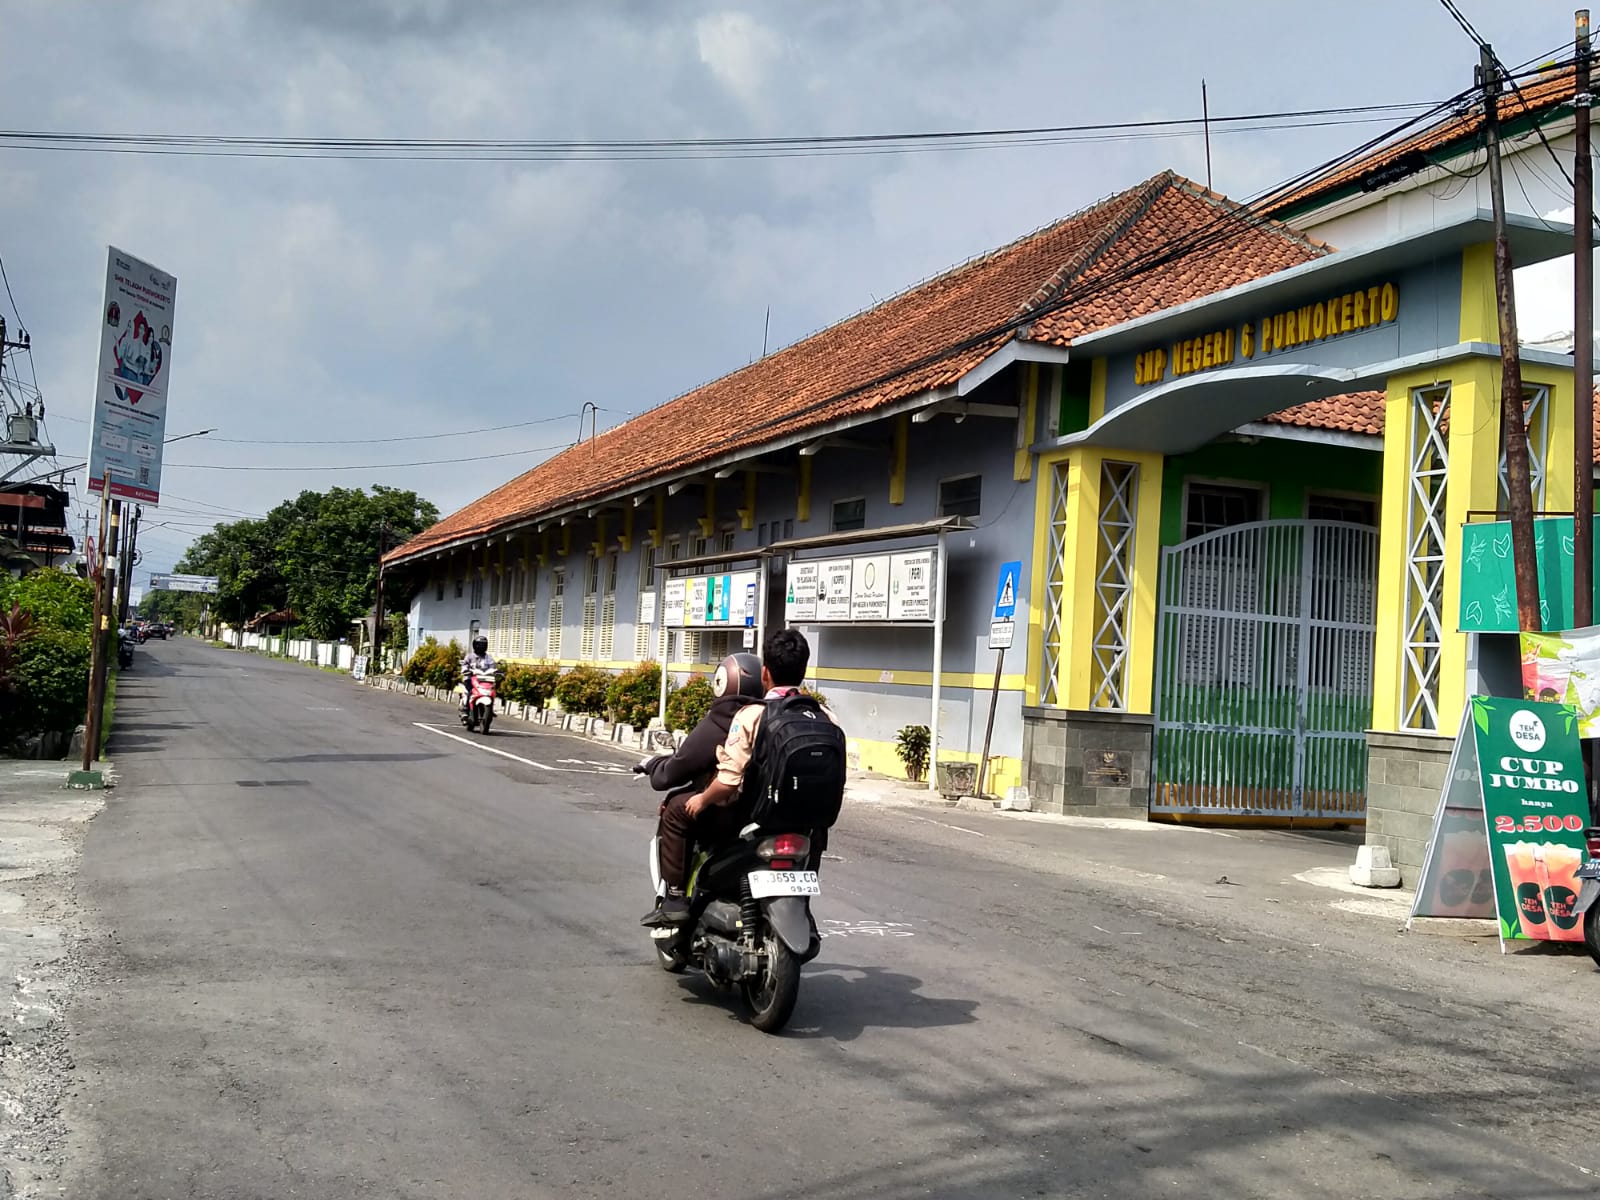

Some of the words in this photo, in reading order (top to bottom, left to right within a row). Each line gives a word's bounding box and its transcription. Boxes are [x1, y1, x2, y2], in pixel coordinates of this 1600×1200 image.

[1135, 350, 1168, 385] SMP
[1172, 329, 1236, 376] NEGERI
[1241, 323, 1256, 359] 6
[1262, 282, 1399, 352] PURWOKERTO
[1519, 724, 1535, 732] TEH
[1516, 731, 1541, 741] DESA
[1500, 756, 1564, 776] CUP
[1489, 773, 1579, 793] JUMBO
[1521, 798, 1554, 809] hanya
[1495, 815, 1584, 833] 2.500
[1550, 901, 1566, 910] TEH
